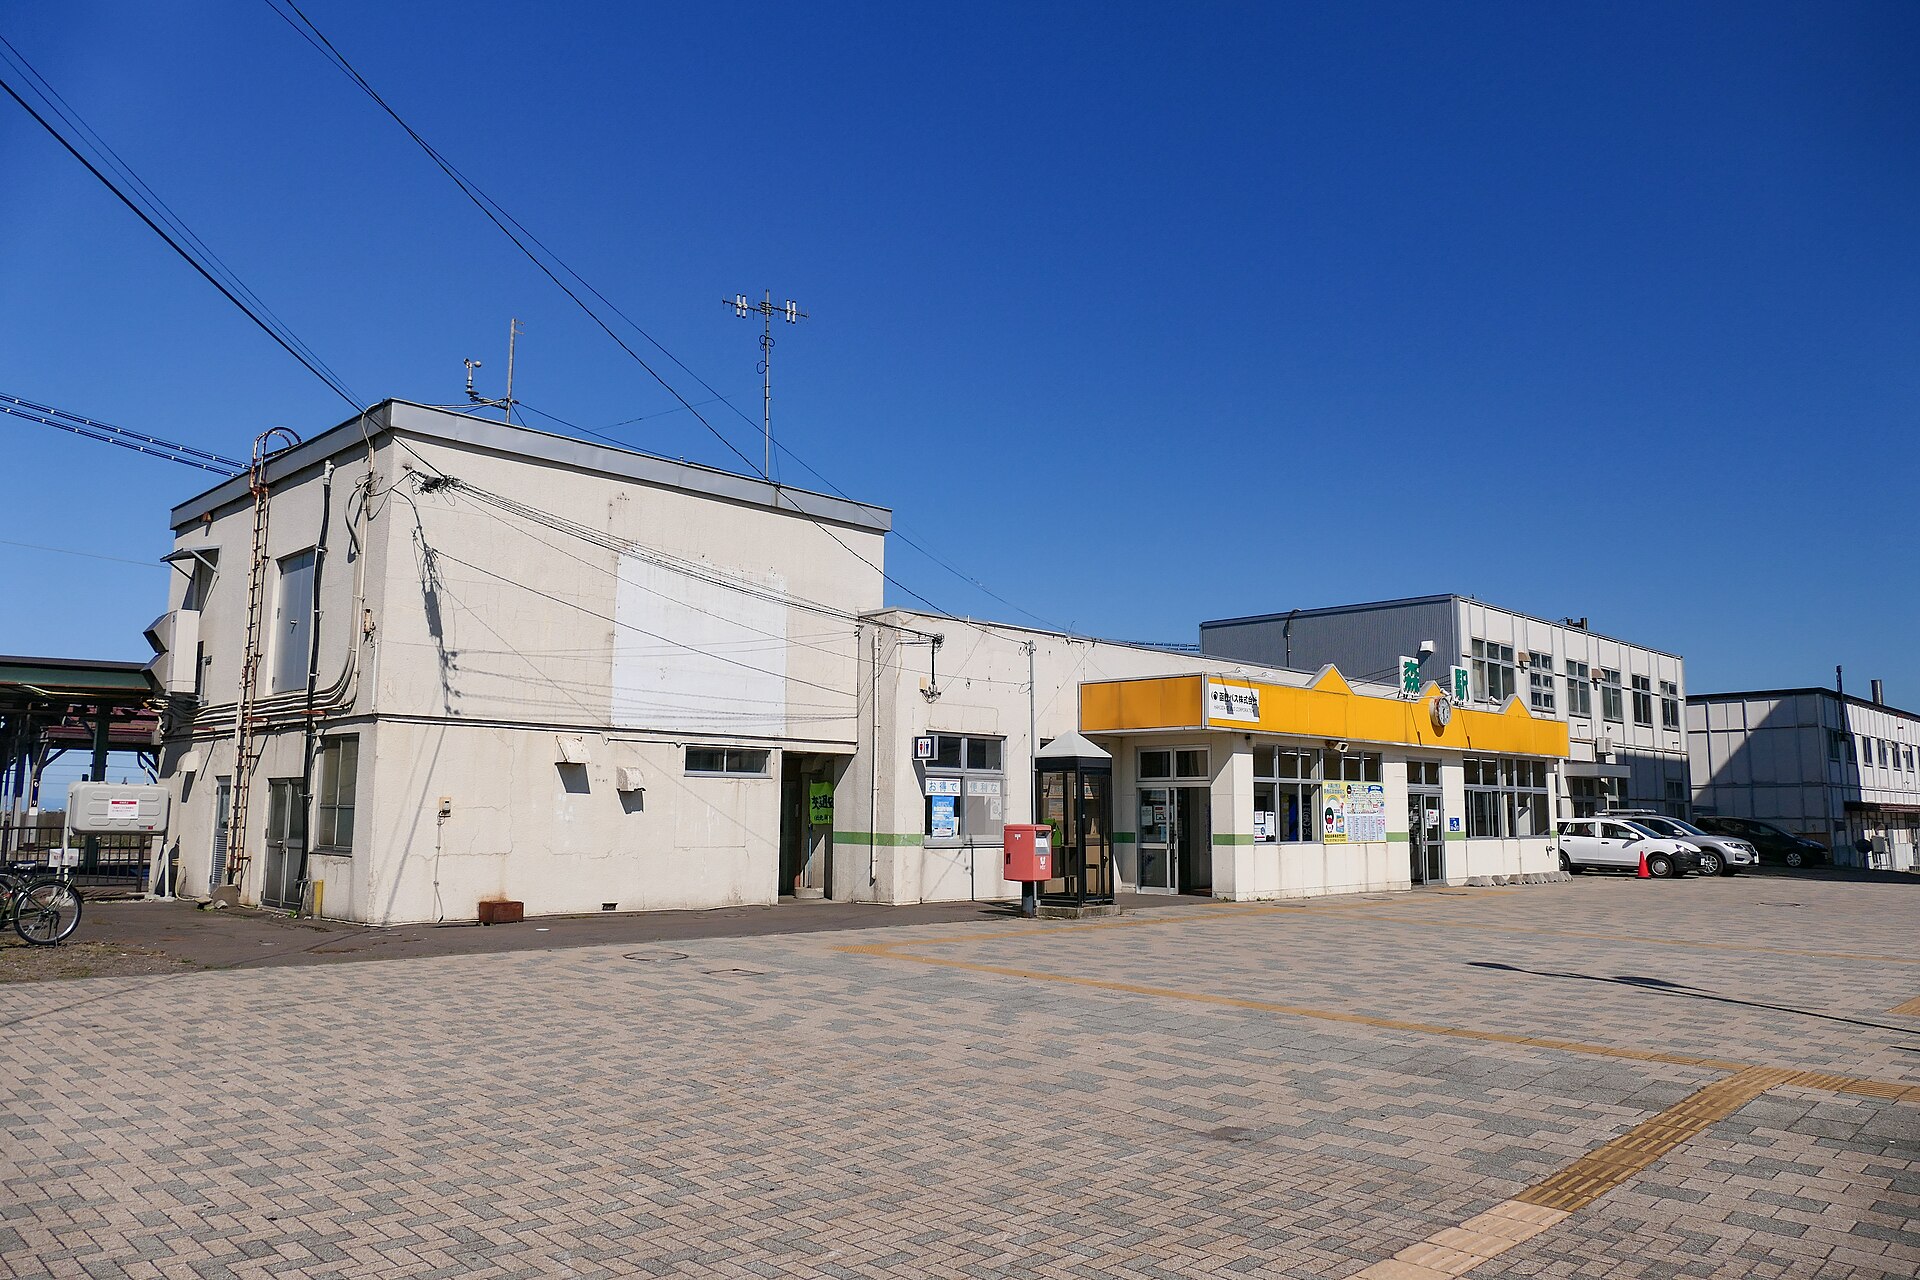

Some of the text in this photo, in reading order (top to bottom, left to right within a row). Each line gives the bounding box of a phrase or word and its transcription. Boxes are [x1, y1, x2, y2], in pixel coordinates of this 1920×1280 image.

[1403, 660, 1420, 694] 森
[1455, 669, 1469, 702] 駅
[928, 781, 998, 792] お得で 便利な
